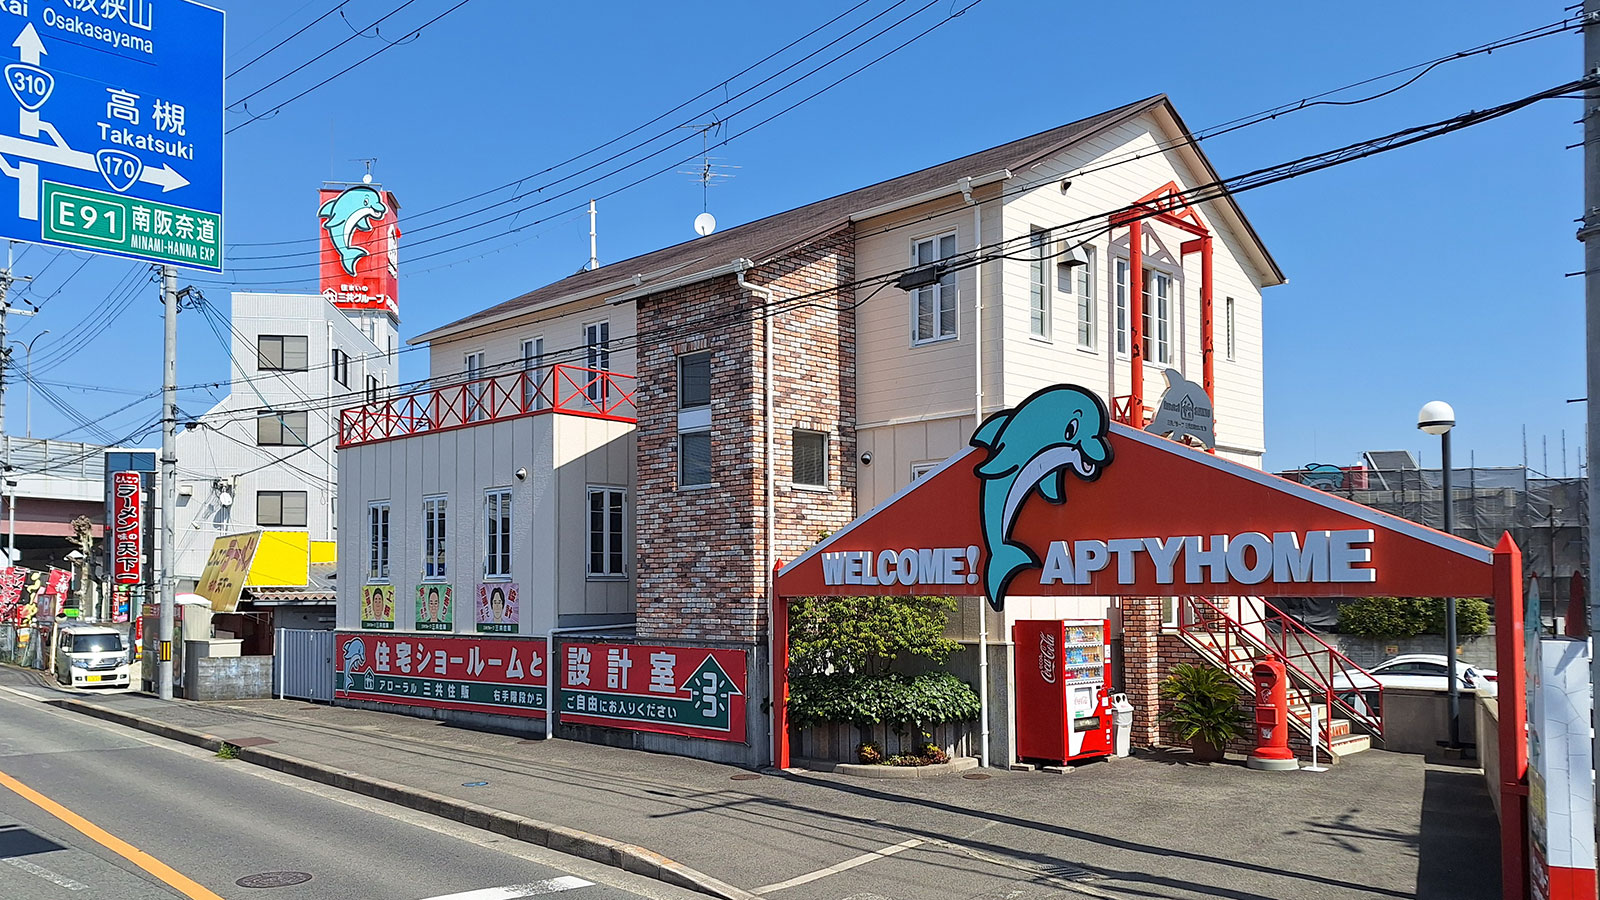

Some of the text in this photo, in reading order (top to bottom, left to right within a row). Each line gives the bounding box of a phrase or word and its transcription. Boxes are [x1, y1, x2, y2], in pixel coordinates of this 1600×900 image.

[43, 7, 153, 54] Osakasayama
[64, 0, 152, 31] 阪狭山
[14, 73, 46, 95] 310
[106, 88, 186, 136] 高槻
[97, 122, 194, 160] Takatsuki
[104, 156, 135, 178] 170
[59, 201, 116, 234] E91
[131, 204, 216, 244] 南阪奈道
[131, 234, 215, 261] MINAMI-HANNA EXP
[337, 293, 385, 304] 三共グループ
[115, 476, 139, 484] とんこつ
[117, 484, 138, 533] ラーメン
[117, 533, 138, 541] 味の
[116, 541, 139, 580] 天下一
[821, 529, 1376, 585] WELCOME! APTYHOME
[375, 640, 543, 680] 住宅ショールームと
[568, 647, 676, 693] 設計室
[1039, 631, 1056, 684] Coca-Cola
[379, 680, 470, 699] アローラル 三共住販
[493, 689, 543, 705] 右手階段から
[567, 694, 677, 719] ご自由にお入りください
